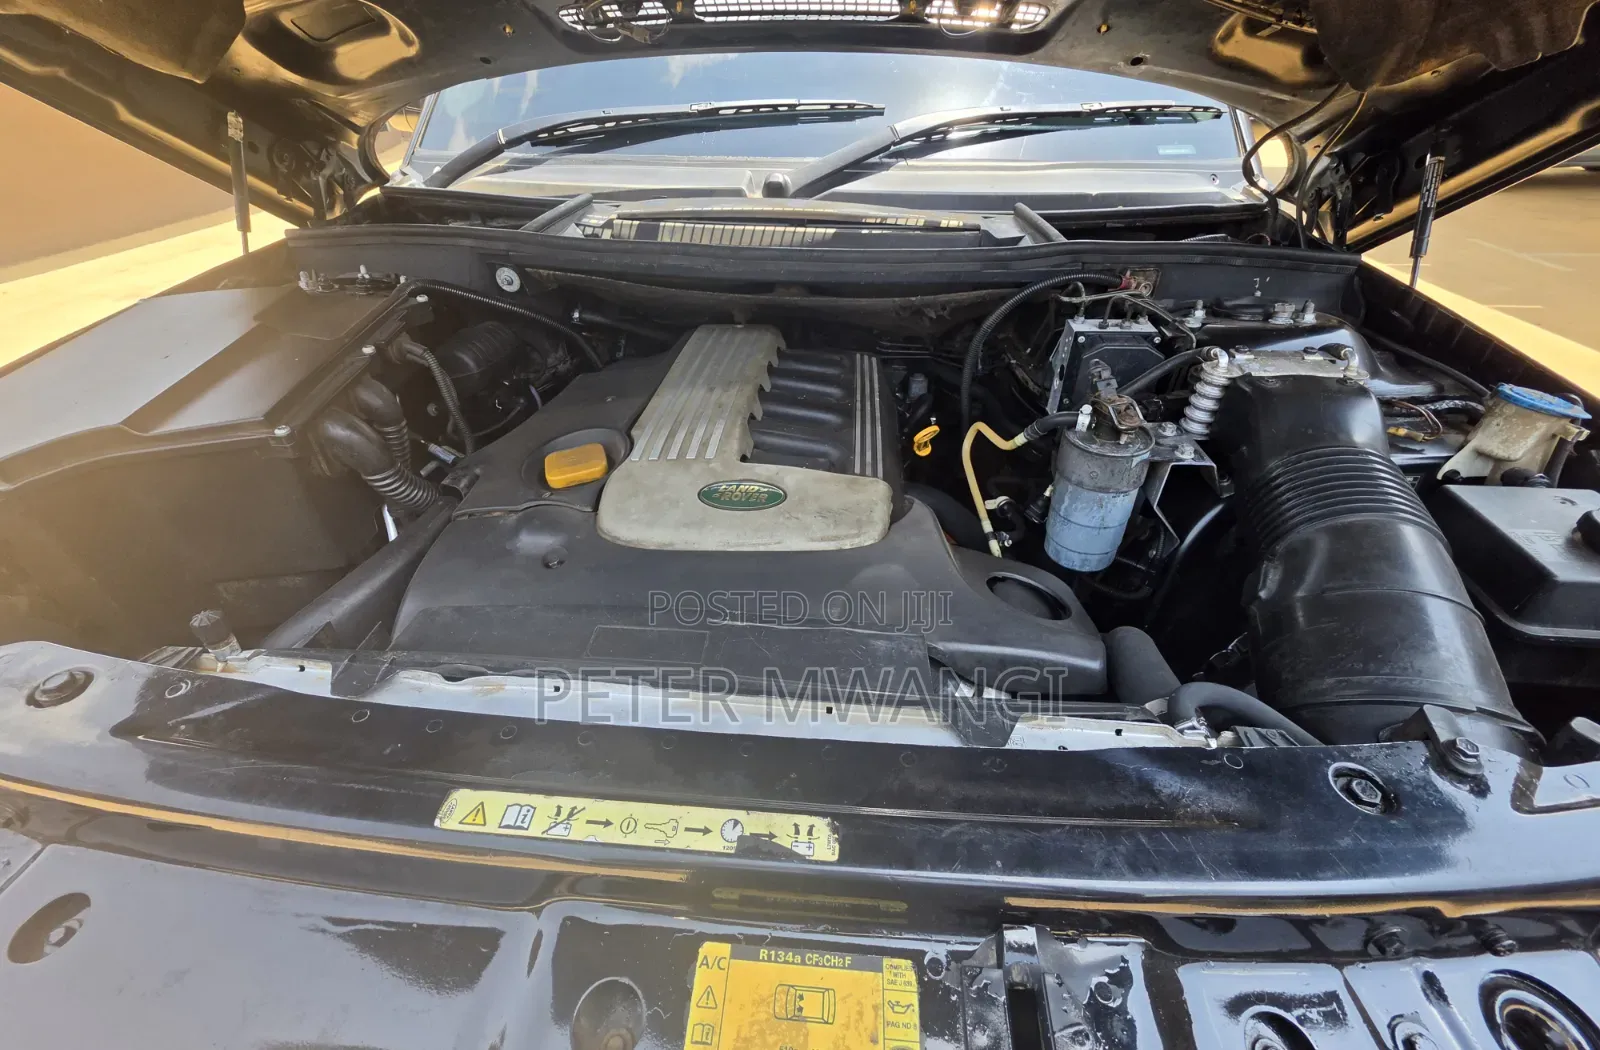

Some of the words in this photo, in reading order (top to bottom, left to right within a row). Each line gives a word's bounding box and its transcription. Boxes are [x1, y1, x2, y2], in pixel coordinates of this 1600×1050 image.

[718, 484, 759, 493] LAND
[720, 492, 768, 503] ROVER
[759, 949, 801, 964] R134a
[698, 955, 727, 971] A/C
[886, 1020, 900, 1029] PAG
[902, 1022, 911, 1030] ND
